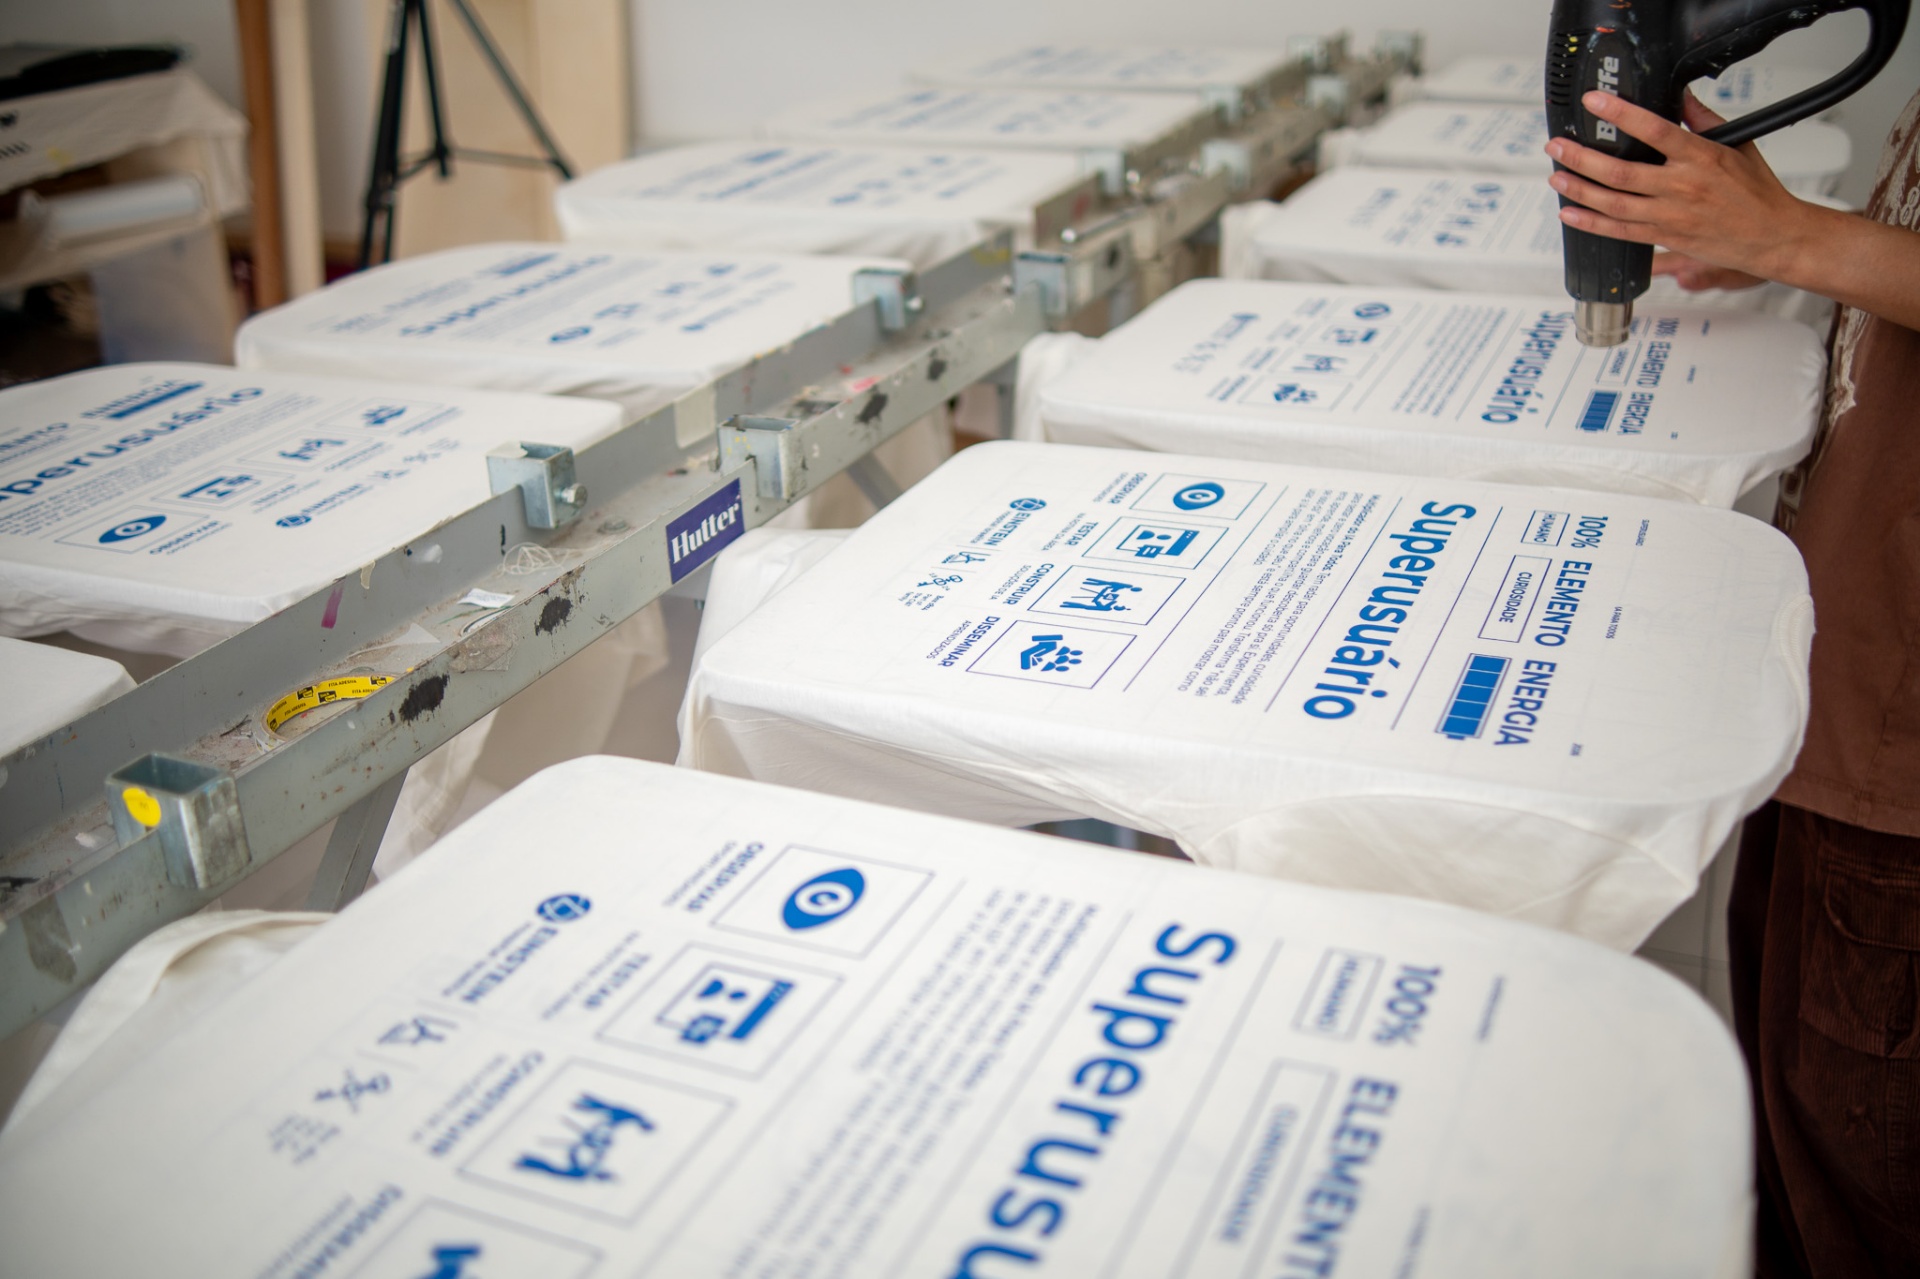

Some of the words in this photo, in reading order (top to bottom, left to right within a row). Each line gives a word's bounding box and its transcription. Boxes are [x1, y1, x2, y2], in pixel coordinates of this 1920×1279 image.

[671, 502, 740, 564] Hutter
[983, 511, 1031, 546] EINSTEIN
[1064, 521, 1099, 546] TESTAR
[1532, 513, 1556, 543] HUMANO
[1570, 515, 1609, 548] 100%
[1313, 571, 1331, 584] Tem
[1321, 553, 1342, 571] Todos.
[1002, 562, 1055, 605] CONSTRUIR
[1302, 585, 1319, 601] radar
[1497, 571, 1533, 623] CURIOSIDADE
[1533, 559, 1592, 647] ELEMENTO
[1266, 589, 1298, 623] descoberta
[1291, 600, 1308, 615] para
[1302, 500, 1477, 720] Superusuário
[925, 619, 972, 659] APRENDIZADOS
[937, 615, 1001, 667] DISSEMINAR
[1214, 631, 1251, 668] Transforma
[1257, 615, 1299, 663] oportunidades,
[1230, 663, 1266, 704] curiosidade
[1493, 659, 1557, 745] ENERGIA
[1373, 964, 1442, 1044] 100%
[1281, 1077, 1398, 1279] ELEMENT
